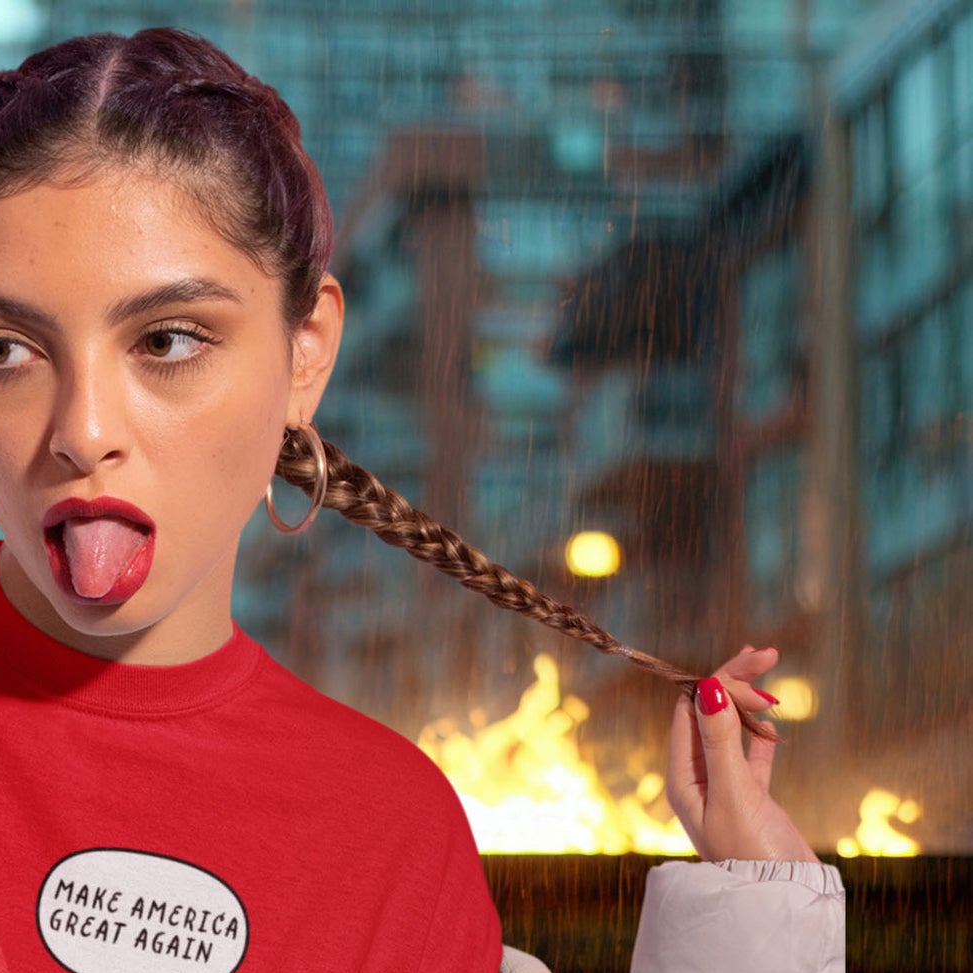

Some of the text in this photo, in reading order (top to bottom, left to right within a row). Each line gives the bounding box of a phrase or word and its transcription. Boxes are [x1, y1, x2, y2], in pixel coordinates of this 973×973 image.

[50, 909, 213, 963] GREAT AGAIN
[55, 879, 238, 939] MAKE AMERICA
